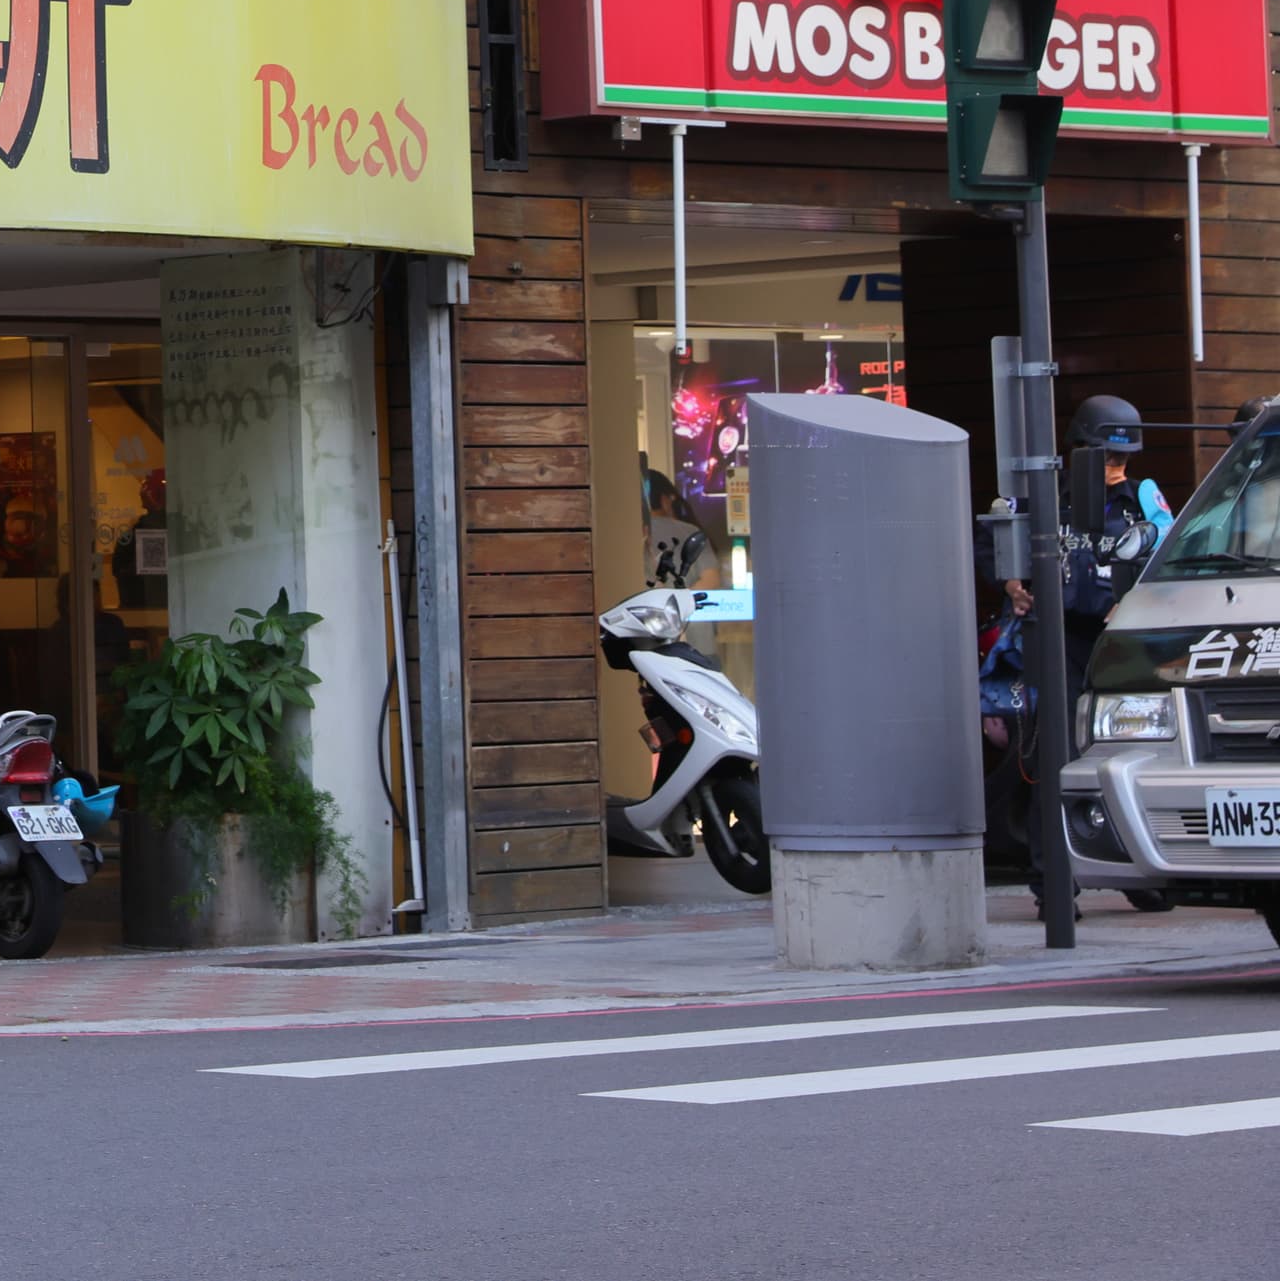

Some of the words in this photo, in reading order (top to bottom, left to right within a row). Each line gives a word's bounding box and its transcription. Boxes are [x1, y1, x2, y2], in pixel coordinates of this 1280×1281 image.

[731, 1, 892, 84] MOS
[903, 9, 1157, 93] BGER
[254, 63, 429, 183] Bread
